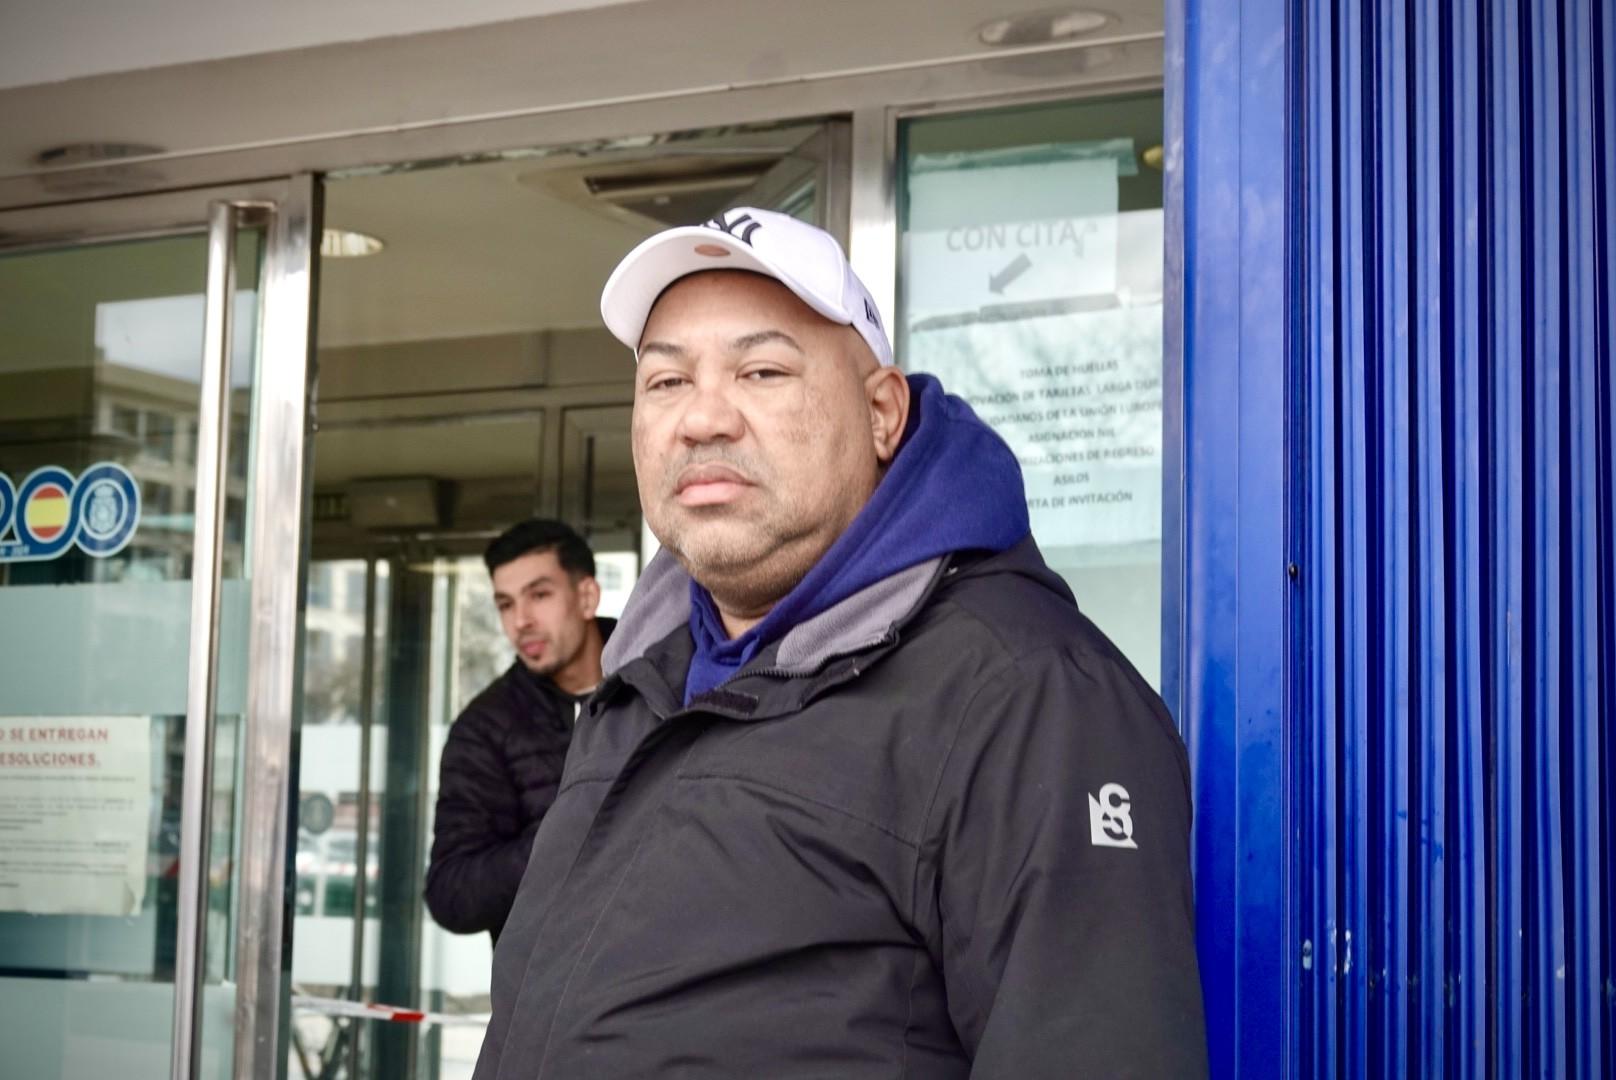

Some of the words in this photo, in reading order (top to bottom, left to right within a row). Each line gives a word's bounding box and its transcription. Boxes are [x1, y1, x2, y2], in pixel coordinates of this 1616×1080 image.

[946, 223, 1006, 251] CON
[1017, 219, 1077, 248] CITA
[1055, 365, 1069, 377] DE
[966, 391, 1019, 405] OVACIÓN
[1046, 409, 1060, 421] DE
[1086, 448, 1100, 461] DE
[1053, 471, 1090, 486] ASILOS
[1027, 496, 1049, 510] RTA
[1051, 495, 1065, 508] DE
[1067, 488, 1133, 505] INVITACIÓN
[10, 727, 24, 742] SE
[29, 727, 109, 743] ENTREGAN
[0, 751, 101, 769] ESOLUCIONES.
